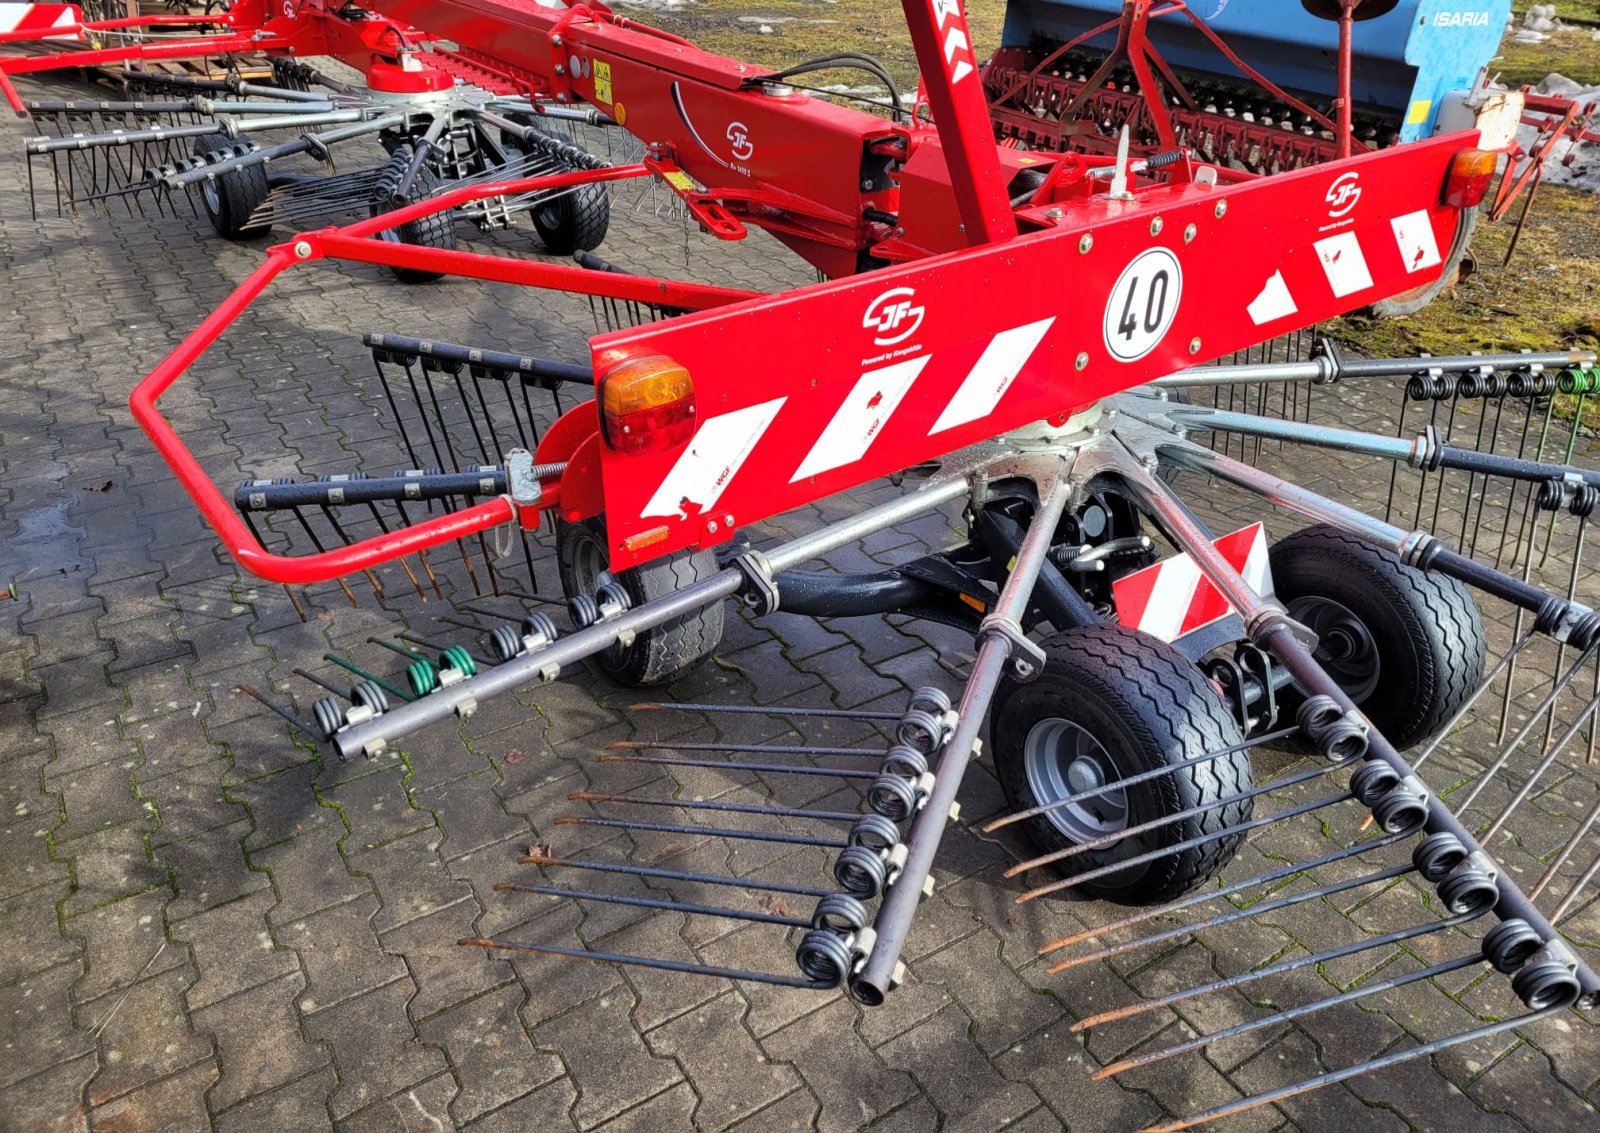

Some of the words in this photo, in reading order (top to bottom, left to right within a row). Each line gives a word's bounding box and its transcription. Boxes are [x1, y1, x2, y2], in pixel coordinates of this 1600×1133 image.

[1433, 11, 1489, 27] ISARIA
[1118, 269, 1169, 341] 40
[715, 466, 731, 486] WGF
